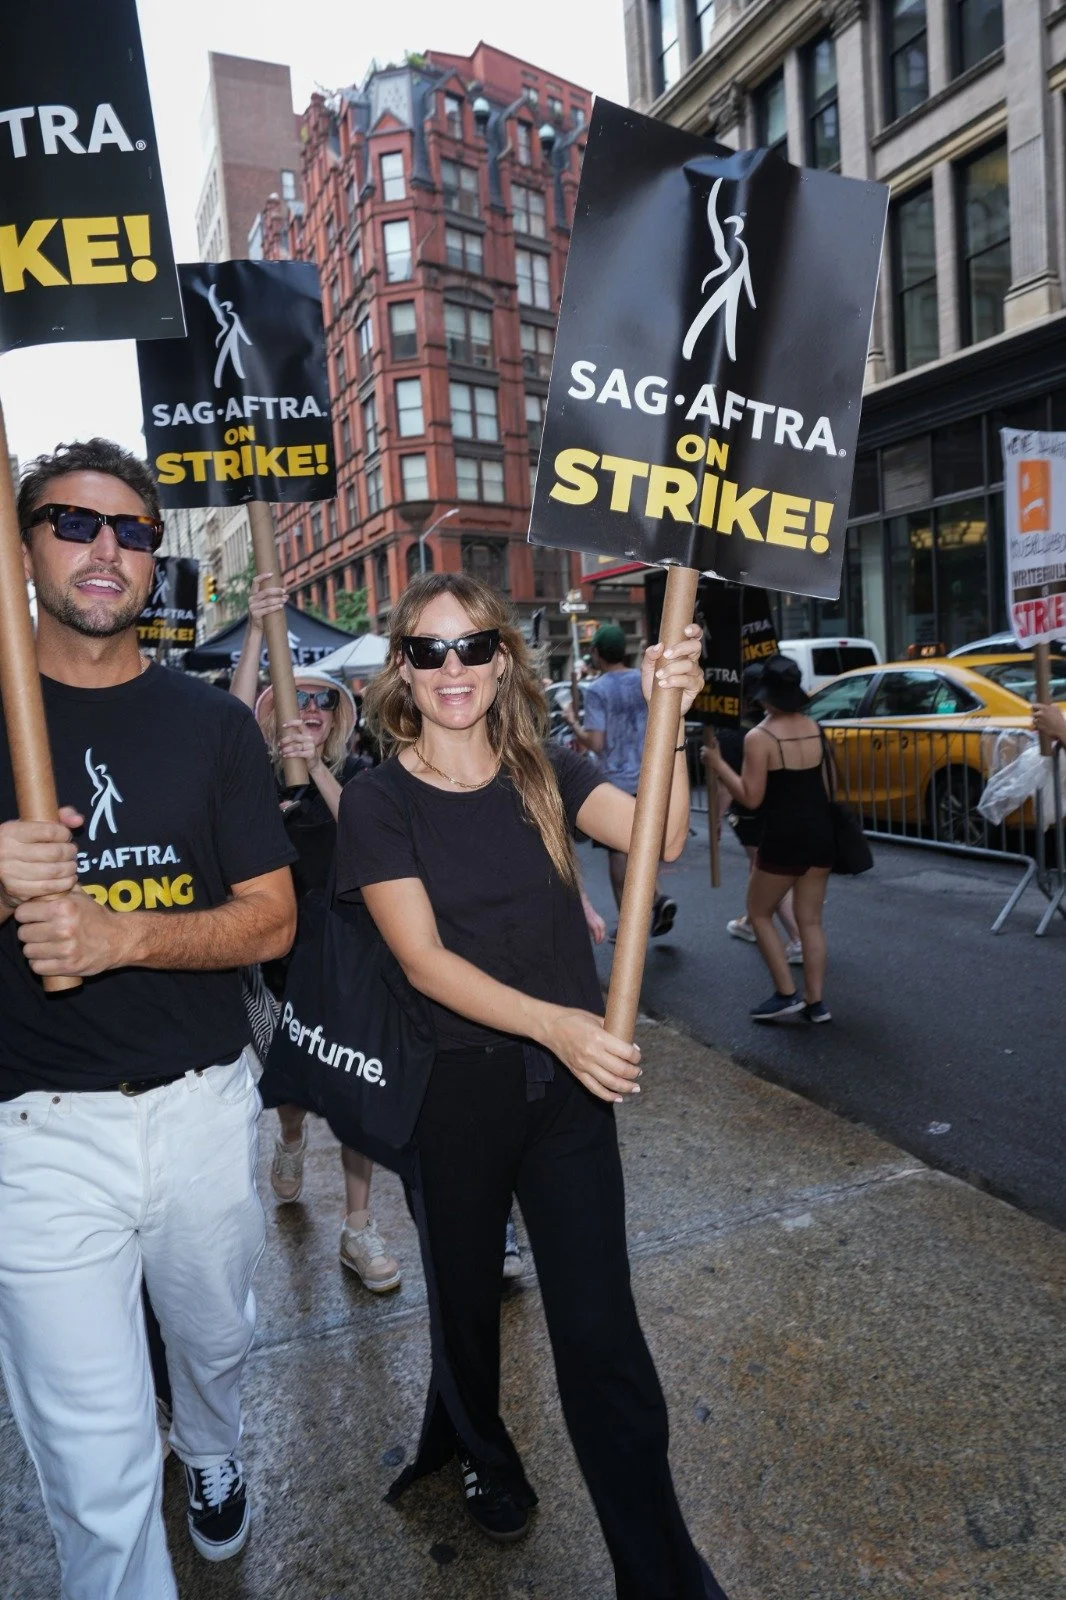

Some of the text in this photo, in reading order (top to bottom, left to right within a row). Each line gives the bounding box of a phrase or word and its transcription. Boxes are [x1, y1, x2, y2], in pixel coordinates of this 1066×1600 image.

[224, 425, 256, 445] ON
[676, 433, 730, 472] ON
[155, 444, 329, 485] STRIKE!
[549, 448, 835, 555] STRIKE!
[281, 1000, 387, 1087] Perfume.
